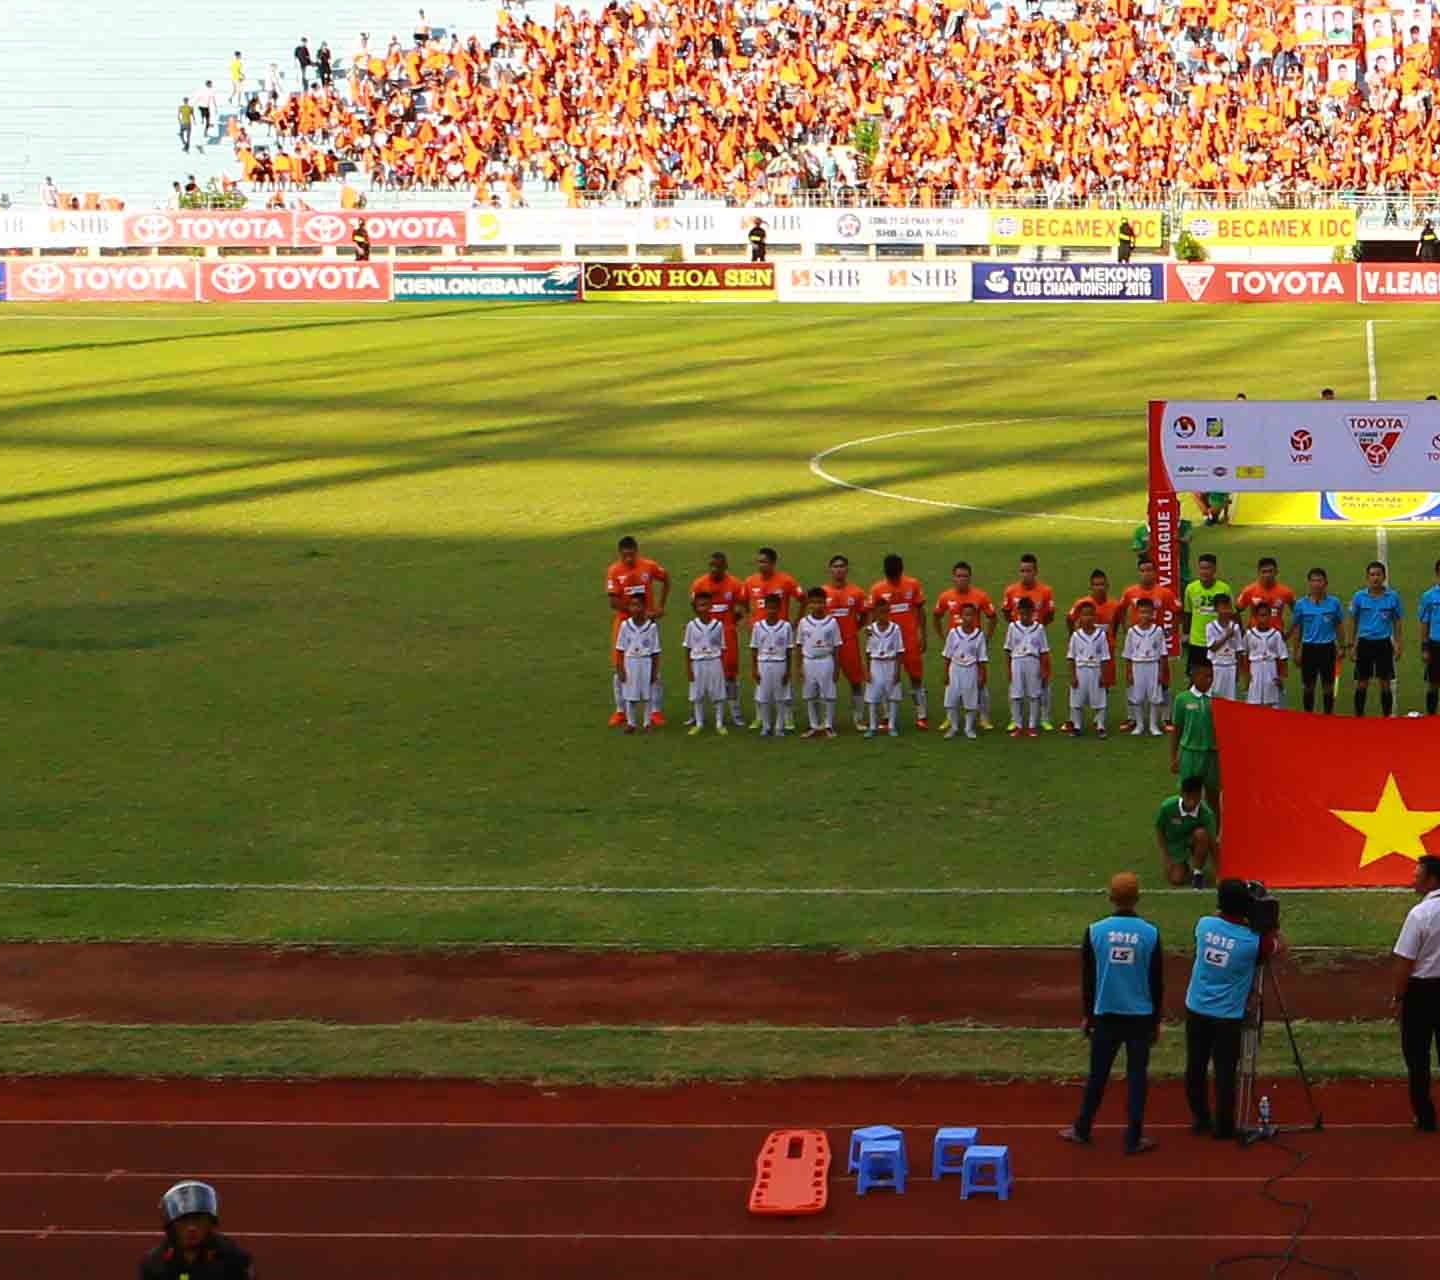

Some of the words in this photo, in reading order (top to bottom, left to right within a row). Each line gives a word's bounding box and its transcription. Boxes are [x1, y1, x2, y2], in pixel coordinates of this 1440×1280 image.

[176, 217, 283, 239] TOYOTA
[674, 216, 715, 231] SHB
[1021, 219, 1117, 239] BECAMEX
[1217, 219, 1310, 239] BECAMEX
[1319, 219, 1352, 239] IDC
[71, 267, 188, 290] TOYOTA
[258, 266, 380, 290] TOYOTA
[612, 264, 662, 287] TÔN
[668, 269, 720, 286] HOA
[724, 269, 773, 286] SEN
[813, 269, 861, 287] SHB
[910, 269, 958, 287] SHB
[1012, 267, 1074, 282] TOYOTA
[1080, 267, 1151, 282] MEKONG
[1225, 271, 1344, 295] TOYOTA
[394, 277, 546, 296] KIENLONGBANK
[1012, 282, 1041, 296] CLUB
[1043, 282, 1123, 296] CHAMPIONSHIP
[1125, 282, 1151, 296] 2016
[1349, 418, 1403, 430] TOYOTA
[1157, 511, 1173, 587] V.LEAGUE
